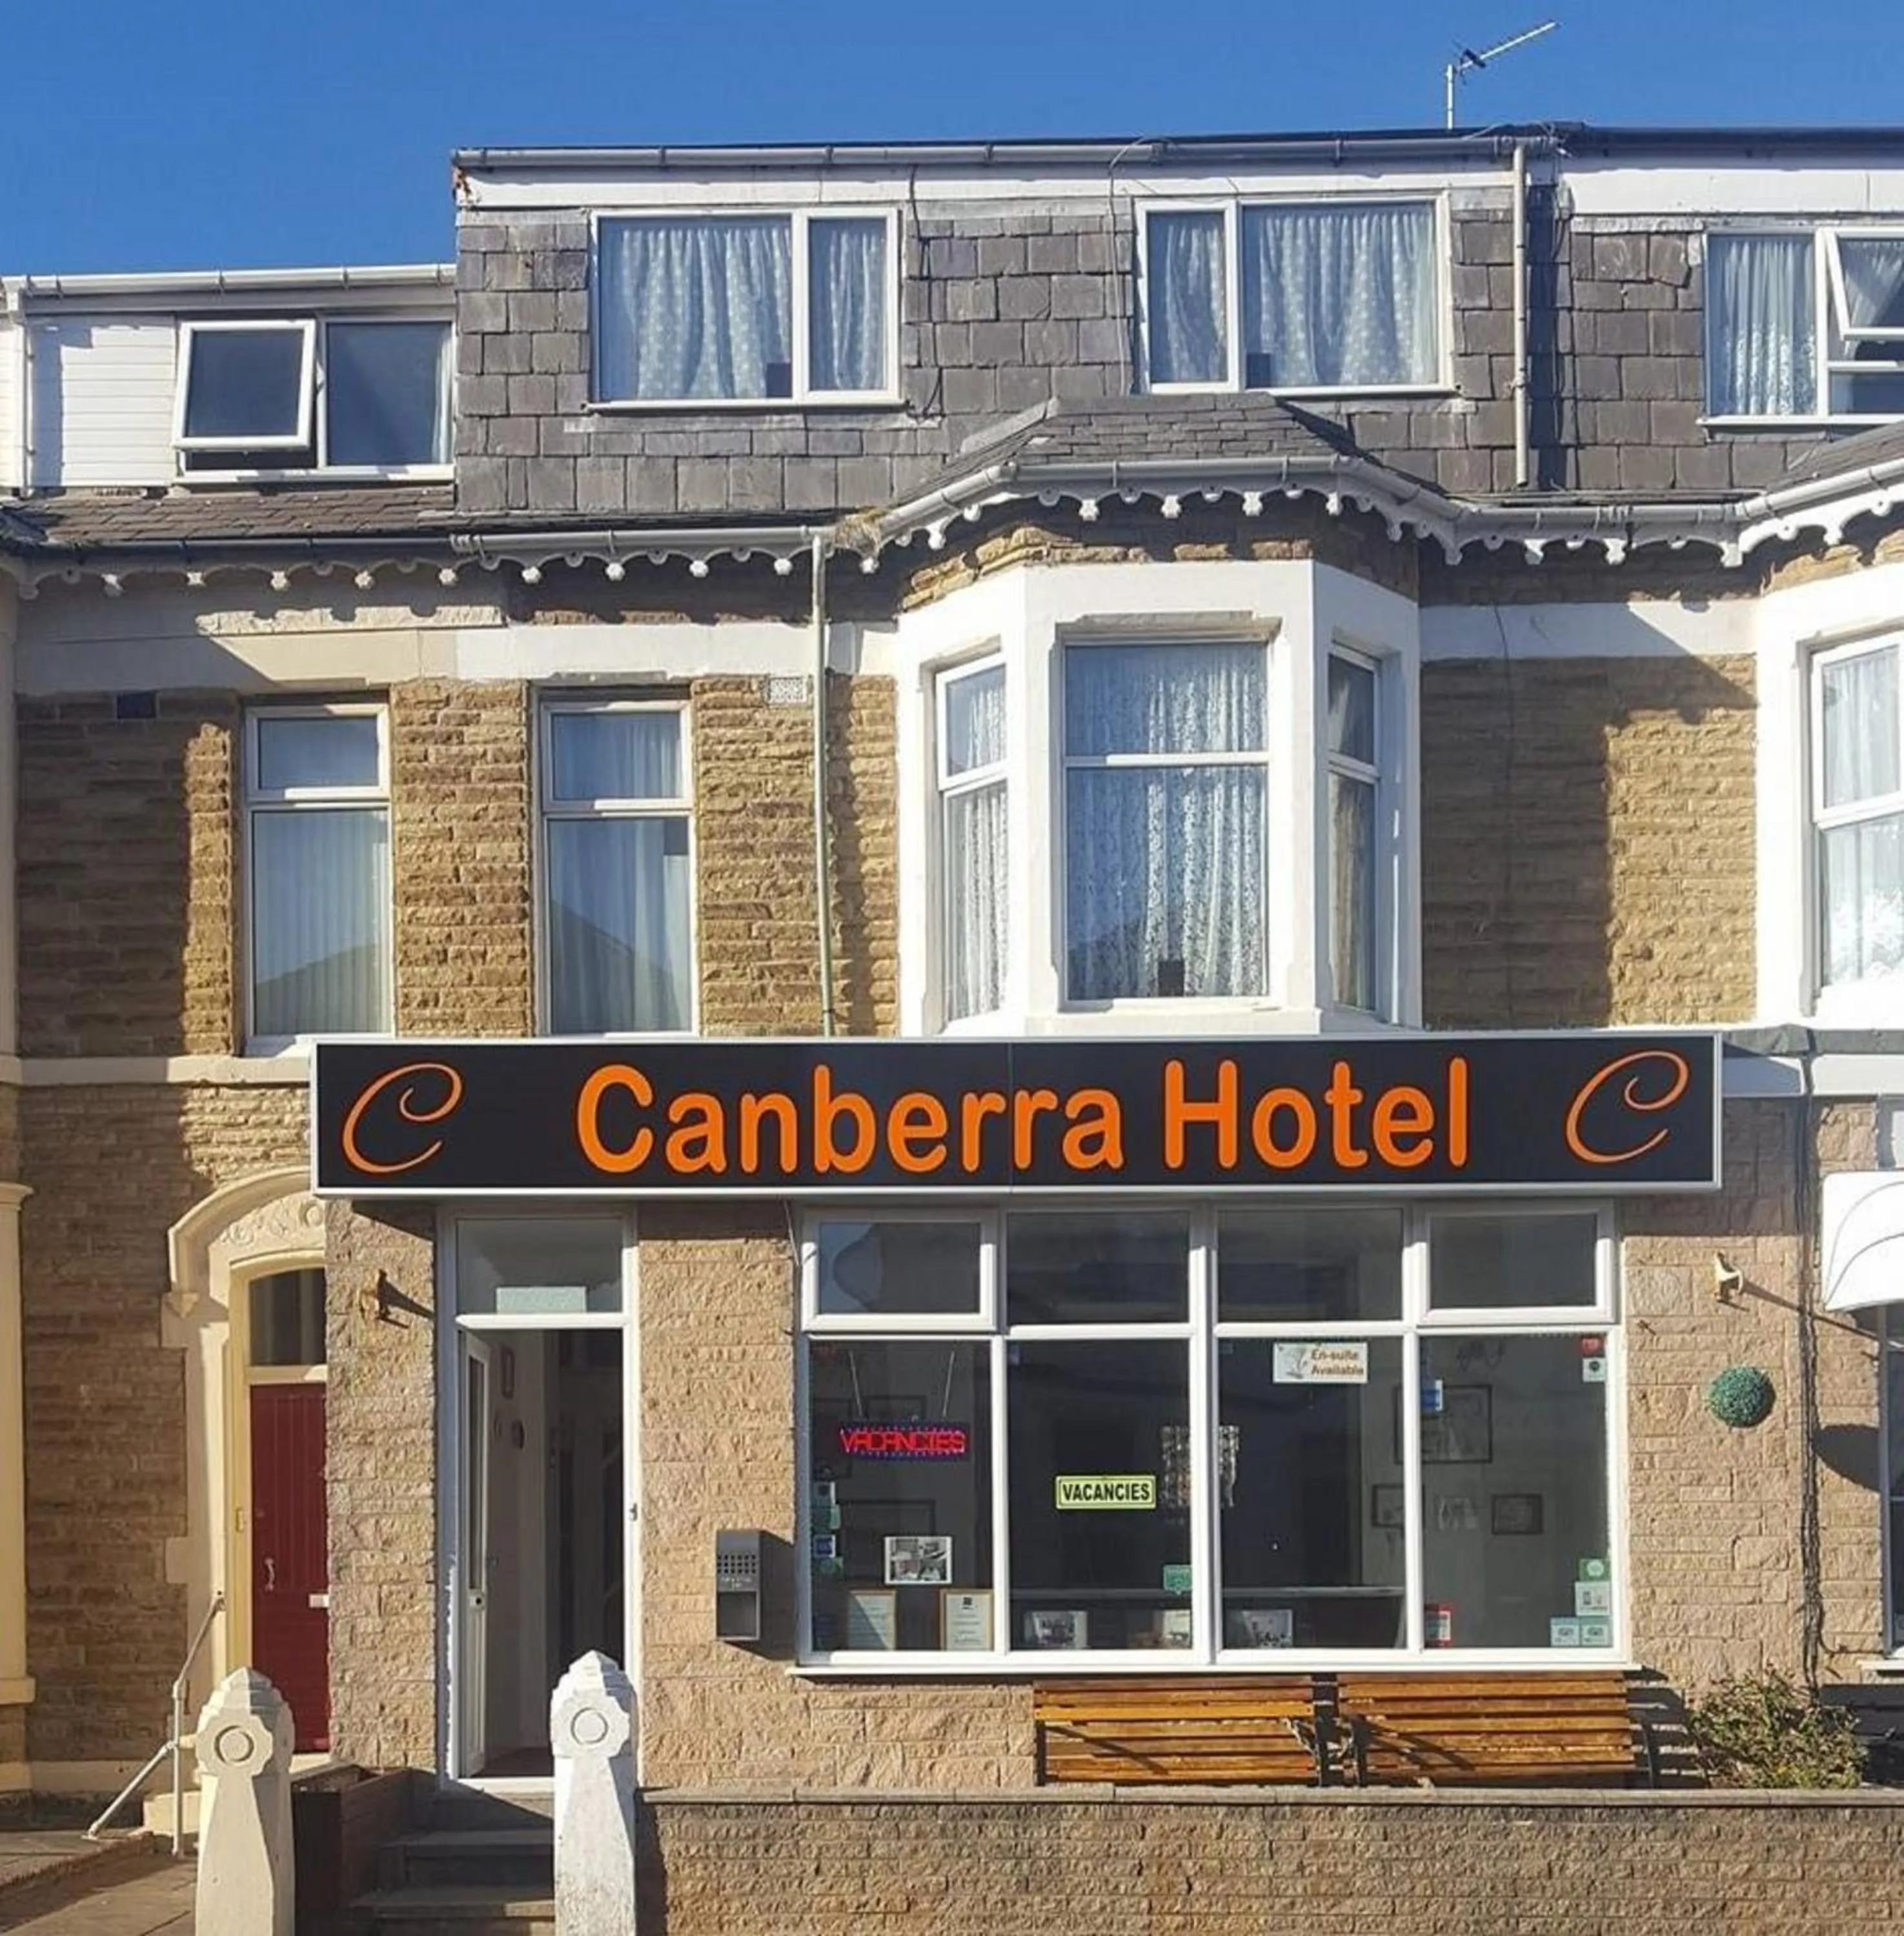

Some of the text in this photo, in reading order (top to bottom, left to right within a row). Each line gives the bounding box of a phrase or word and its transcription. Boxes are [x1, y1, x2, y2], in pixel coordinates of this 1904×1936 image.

[341, 1062, 462, 1173] C
[577, 1056, 1468, 1173] Canberra Hotel
[1566, 1050, 1688, 1163] C
[1311, 1364, 1364, 1375] Available
[840, 1429, 966, 1453] VACANCIES
[1062, 1483, 1150, 1501] VACANCIES
